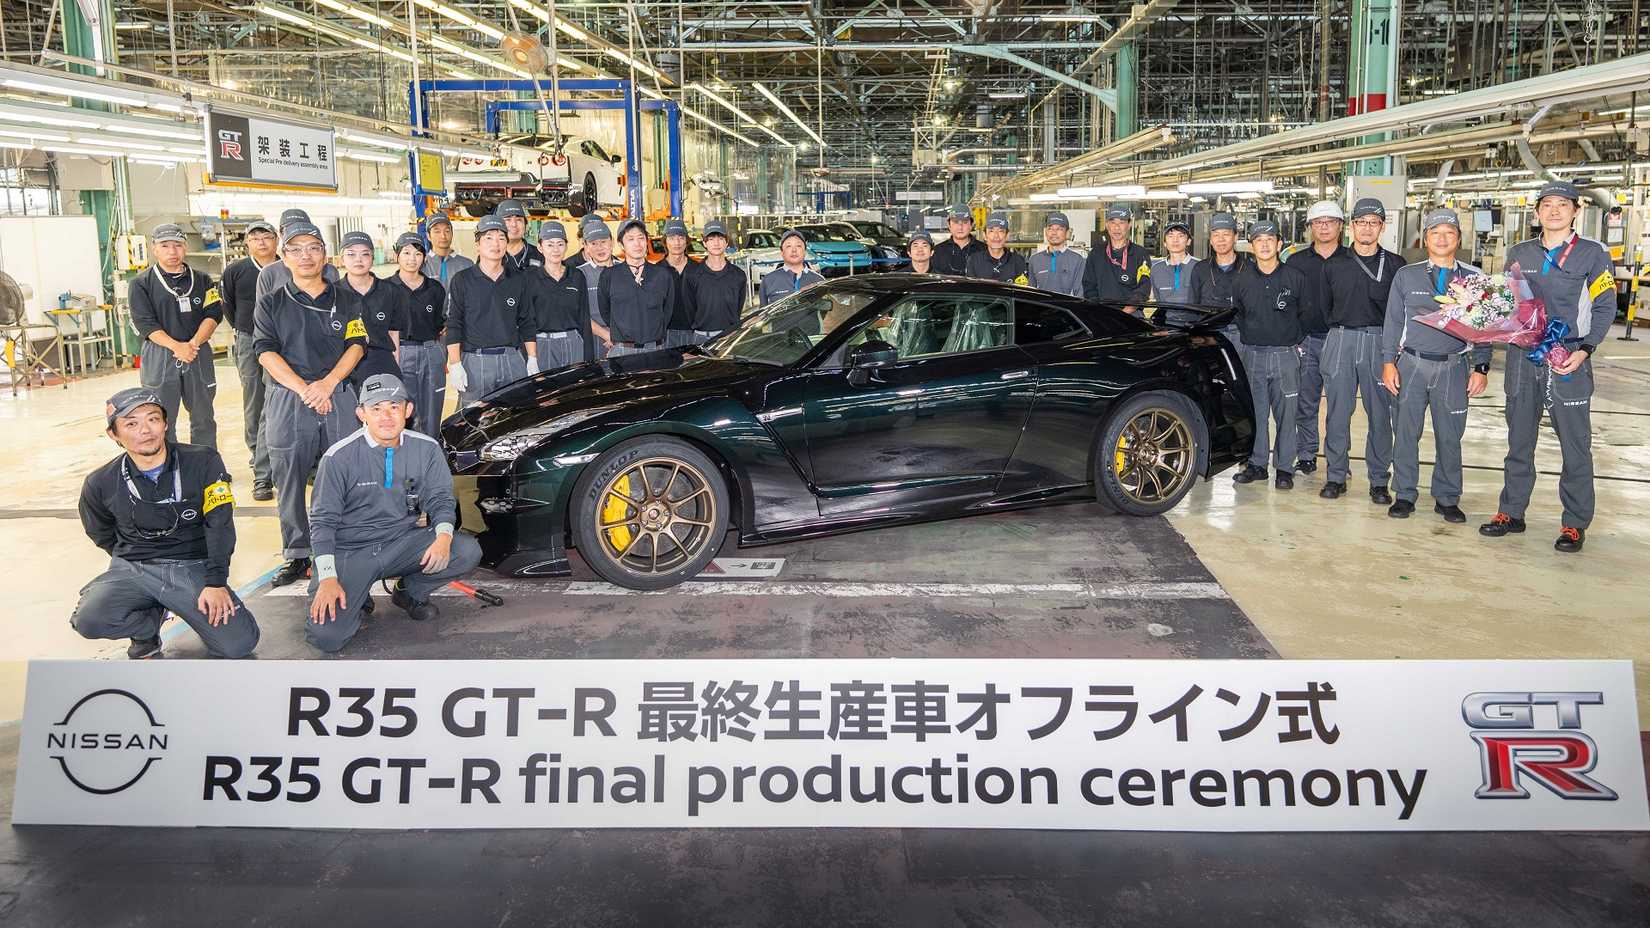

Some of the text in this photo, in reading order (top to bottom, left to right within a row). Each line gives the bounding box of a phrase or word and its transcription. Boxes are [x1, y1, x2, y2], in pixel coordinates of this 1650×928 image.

[257, 135, 328, 162] 架装工程
[258, 156, 275, 165] Special
[589, 449, 639, 501] DUNLOP
[287, 679, 1341, 745] R35 GT-R 最終生産車オフライン式
[47, 732, 169, 751] NISSAN
[202, 752, 1428, 821] R35 GT-R final production ceremony
